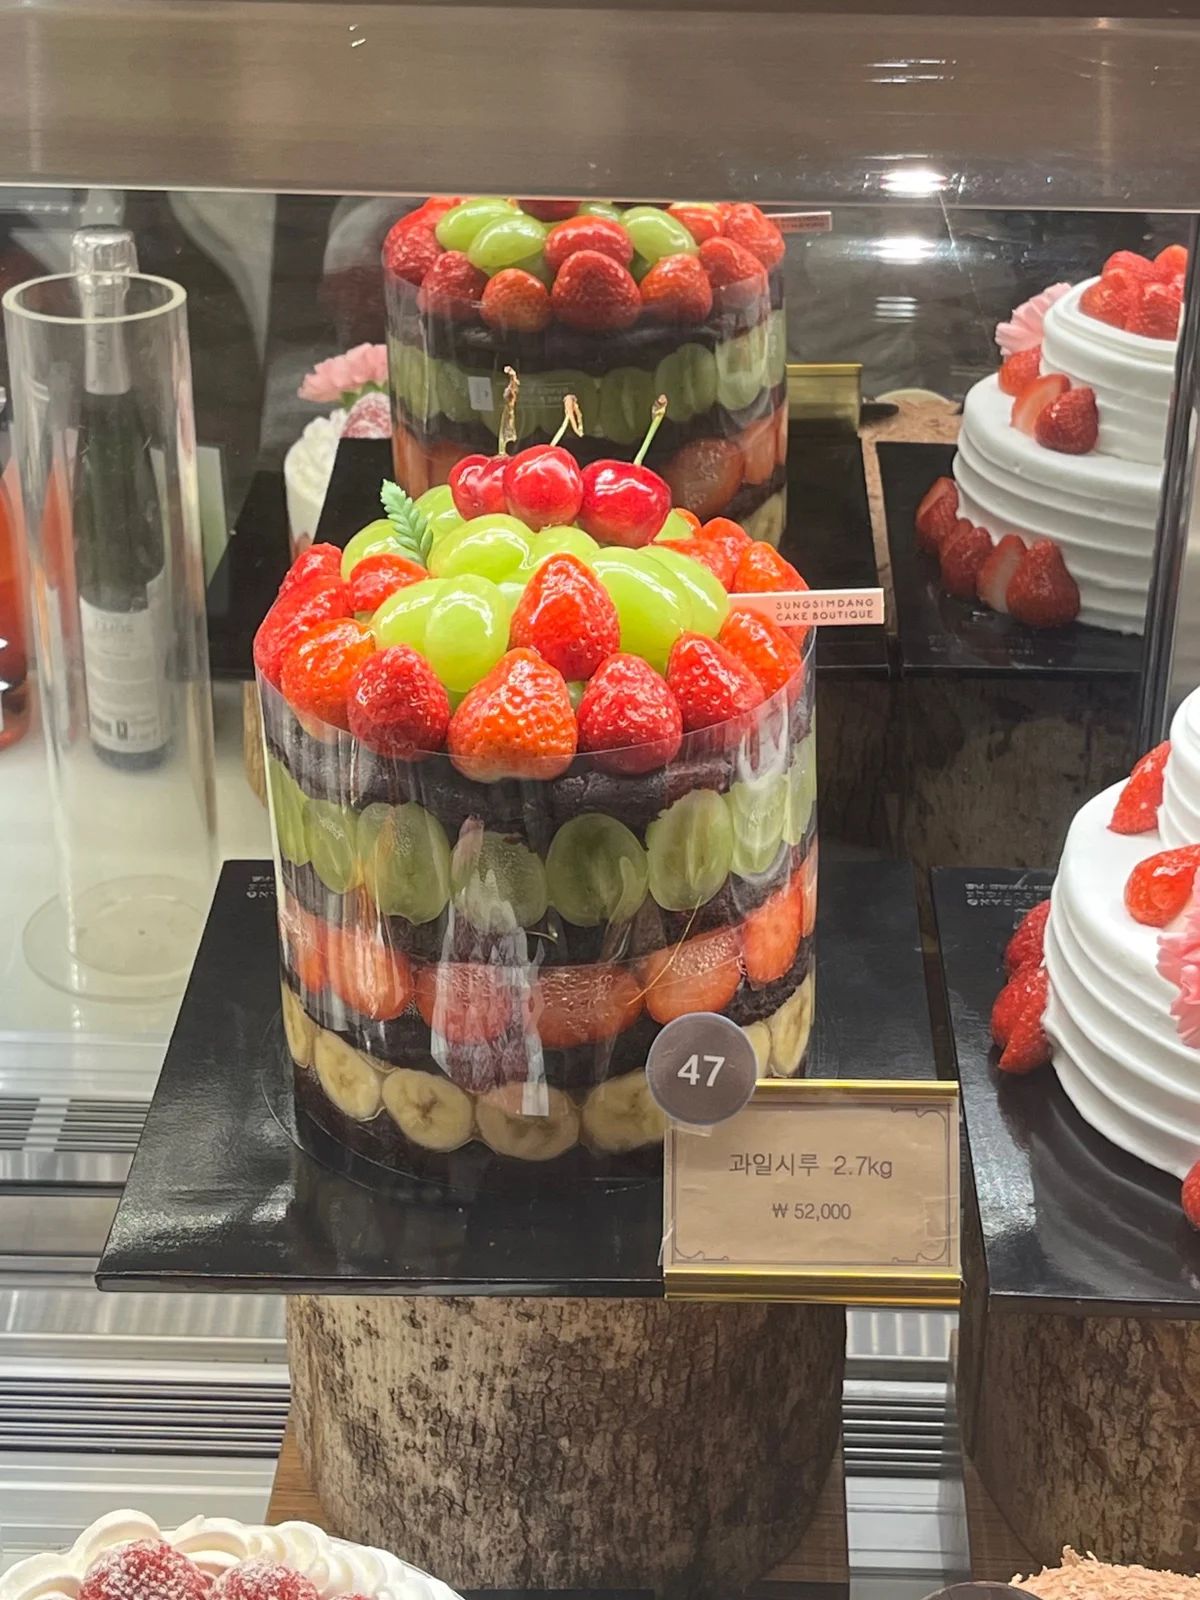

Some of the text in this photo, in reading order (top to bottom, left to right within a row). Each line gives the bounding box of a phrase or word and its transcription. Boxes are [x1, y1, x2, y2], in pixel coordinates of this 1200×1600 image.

[776, 598, 874, 610] SUNGSIMDANG
[776, 609, 873, 622] CAKE BOUTIQUE
[677, 1054, 726, 1087] 47
[728, 1152, 893, 1179] 과일시루 2.7kg
[793, 1202, 852, 1222] 52,000
